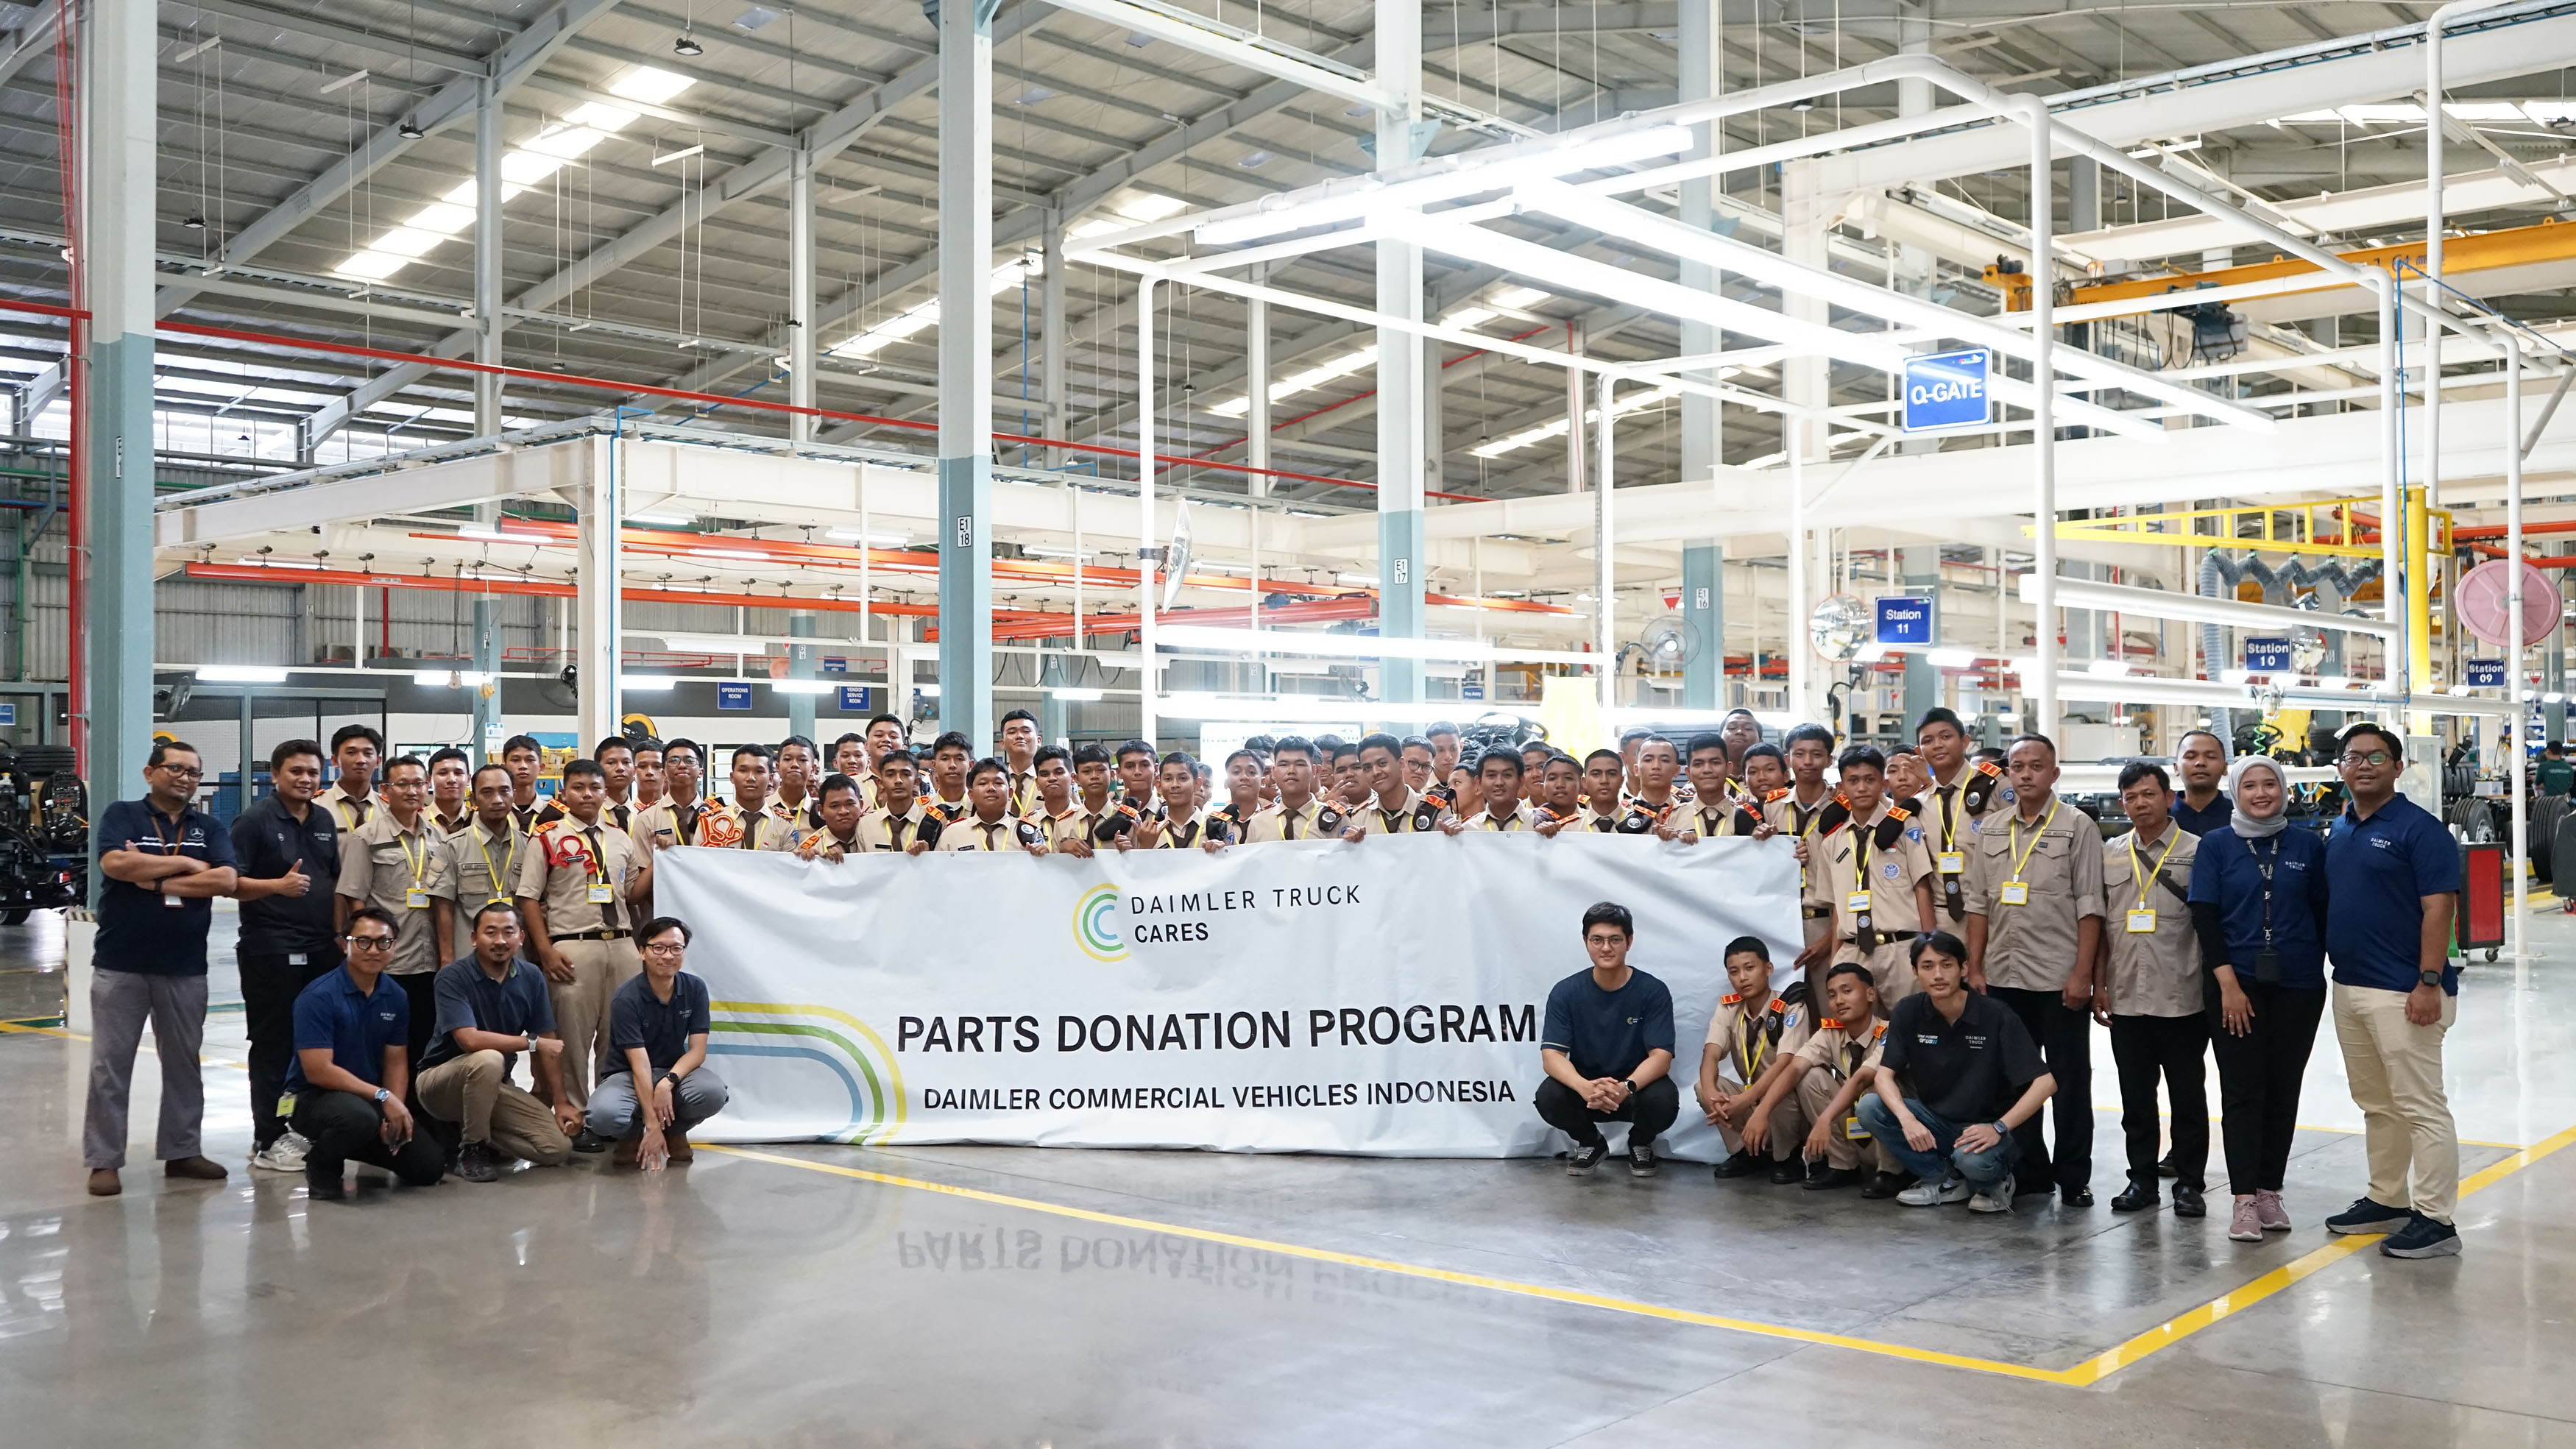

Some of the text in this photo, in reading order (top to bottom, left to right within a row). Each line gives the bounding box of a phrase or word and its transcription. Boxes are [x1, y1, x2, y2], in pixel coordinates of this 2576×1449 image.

[1911, 380, 1983, 405] Q-GATE
[960, 518, 968, 531] E1
[960, 533, 969, 545] 18
[1396, 560, 1404, 570] E1
[1398, 573, 1406, 583] 17
[1698, 589, 1705, 598] E1
[1886, 609, 1921, 620] Station
[1896, 623, 1908, 634] 11
[2248, 642, 2289, 653] Station
[2260, 656, 2276, 666] 10
[2469, 664, 2503, 673] Station
[2480, 674, 2492, 683] 09
[2371, 837, 2391, 846] DAIMLER
[1131, 885, 1360, 915] DAIMLER TRUCK
[1134, 922, 1209, 943] CARES
[898, 1004, 1536, 1052] PARTS DONATION PROGRAM
[924, 1080, 1516, 1110] DAIMLER COMMERCIAL VEHICLES INDONESIA
